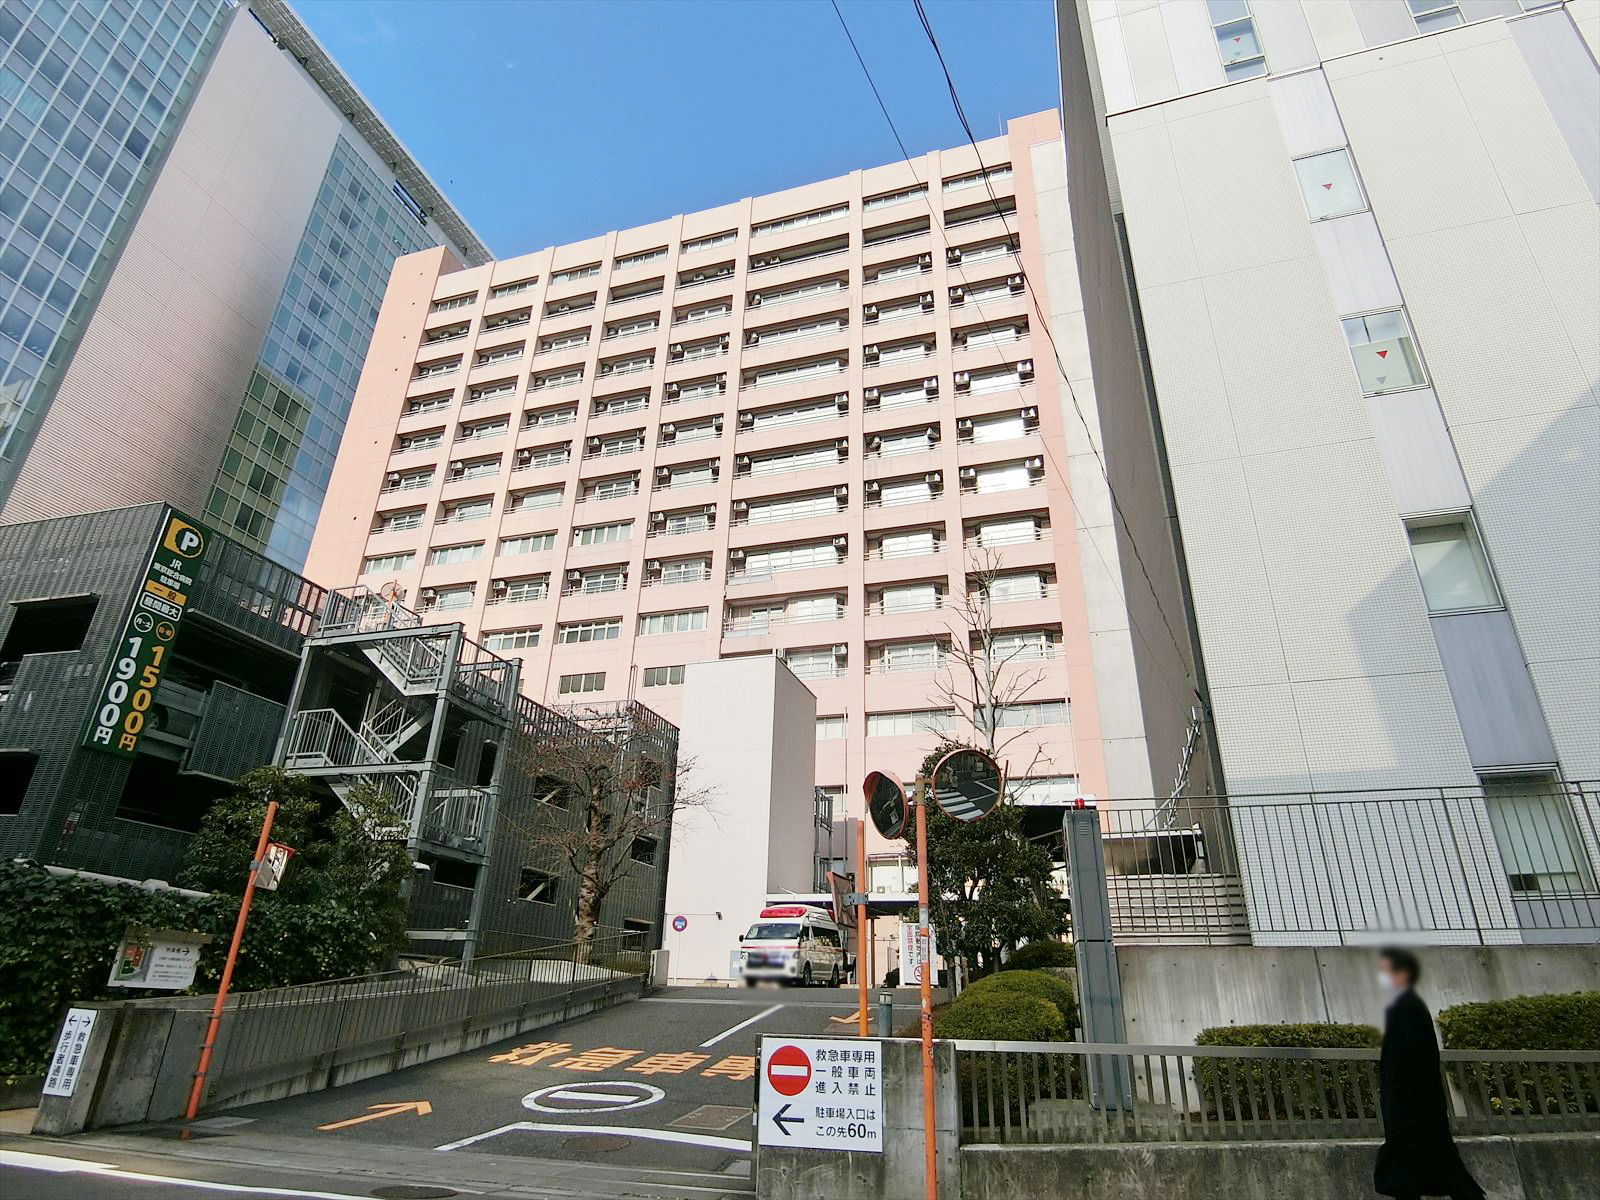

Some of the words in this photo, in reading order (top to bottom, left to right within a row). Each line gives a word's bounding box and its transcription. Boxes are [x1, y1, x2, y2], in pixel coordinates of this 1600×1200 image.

[170, 558, 182, 570] JR
[154, 586, 177, 601] 一般
[143, 596, 179, 618] 昼間最大
[48, 1030, 73, 1089] 歩行者通路
[61, 1032, 87, 1090] 救急車専用
[815, 1048, 875, 1063] 救急車専用
[815, 1065, 876, 1080] 一般車両
[815, 1081, 876, 1097] 進入禁止
[815, 1106, 876, 1121] 駐車場入口は
[816, 1123, 877, 1139] この先60m
